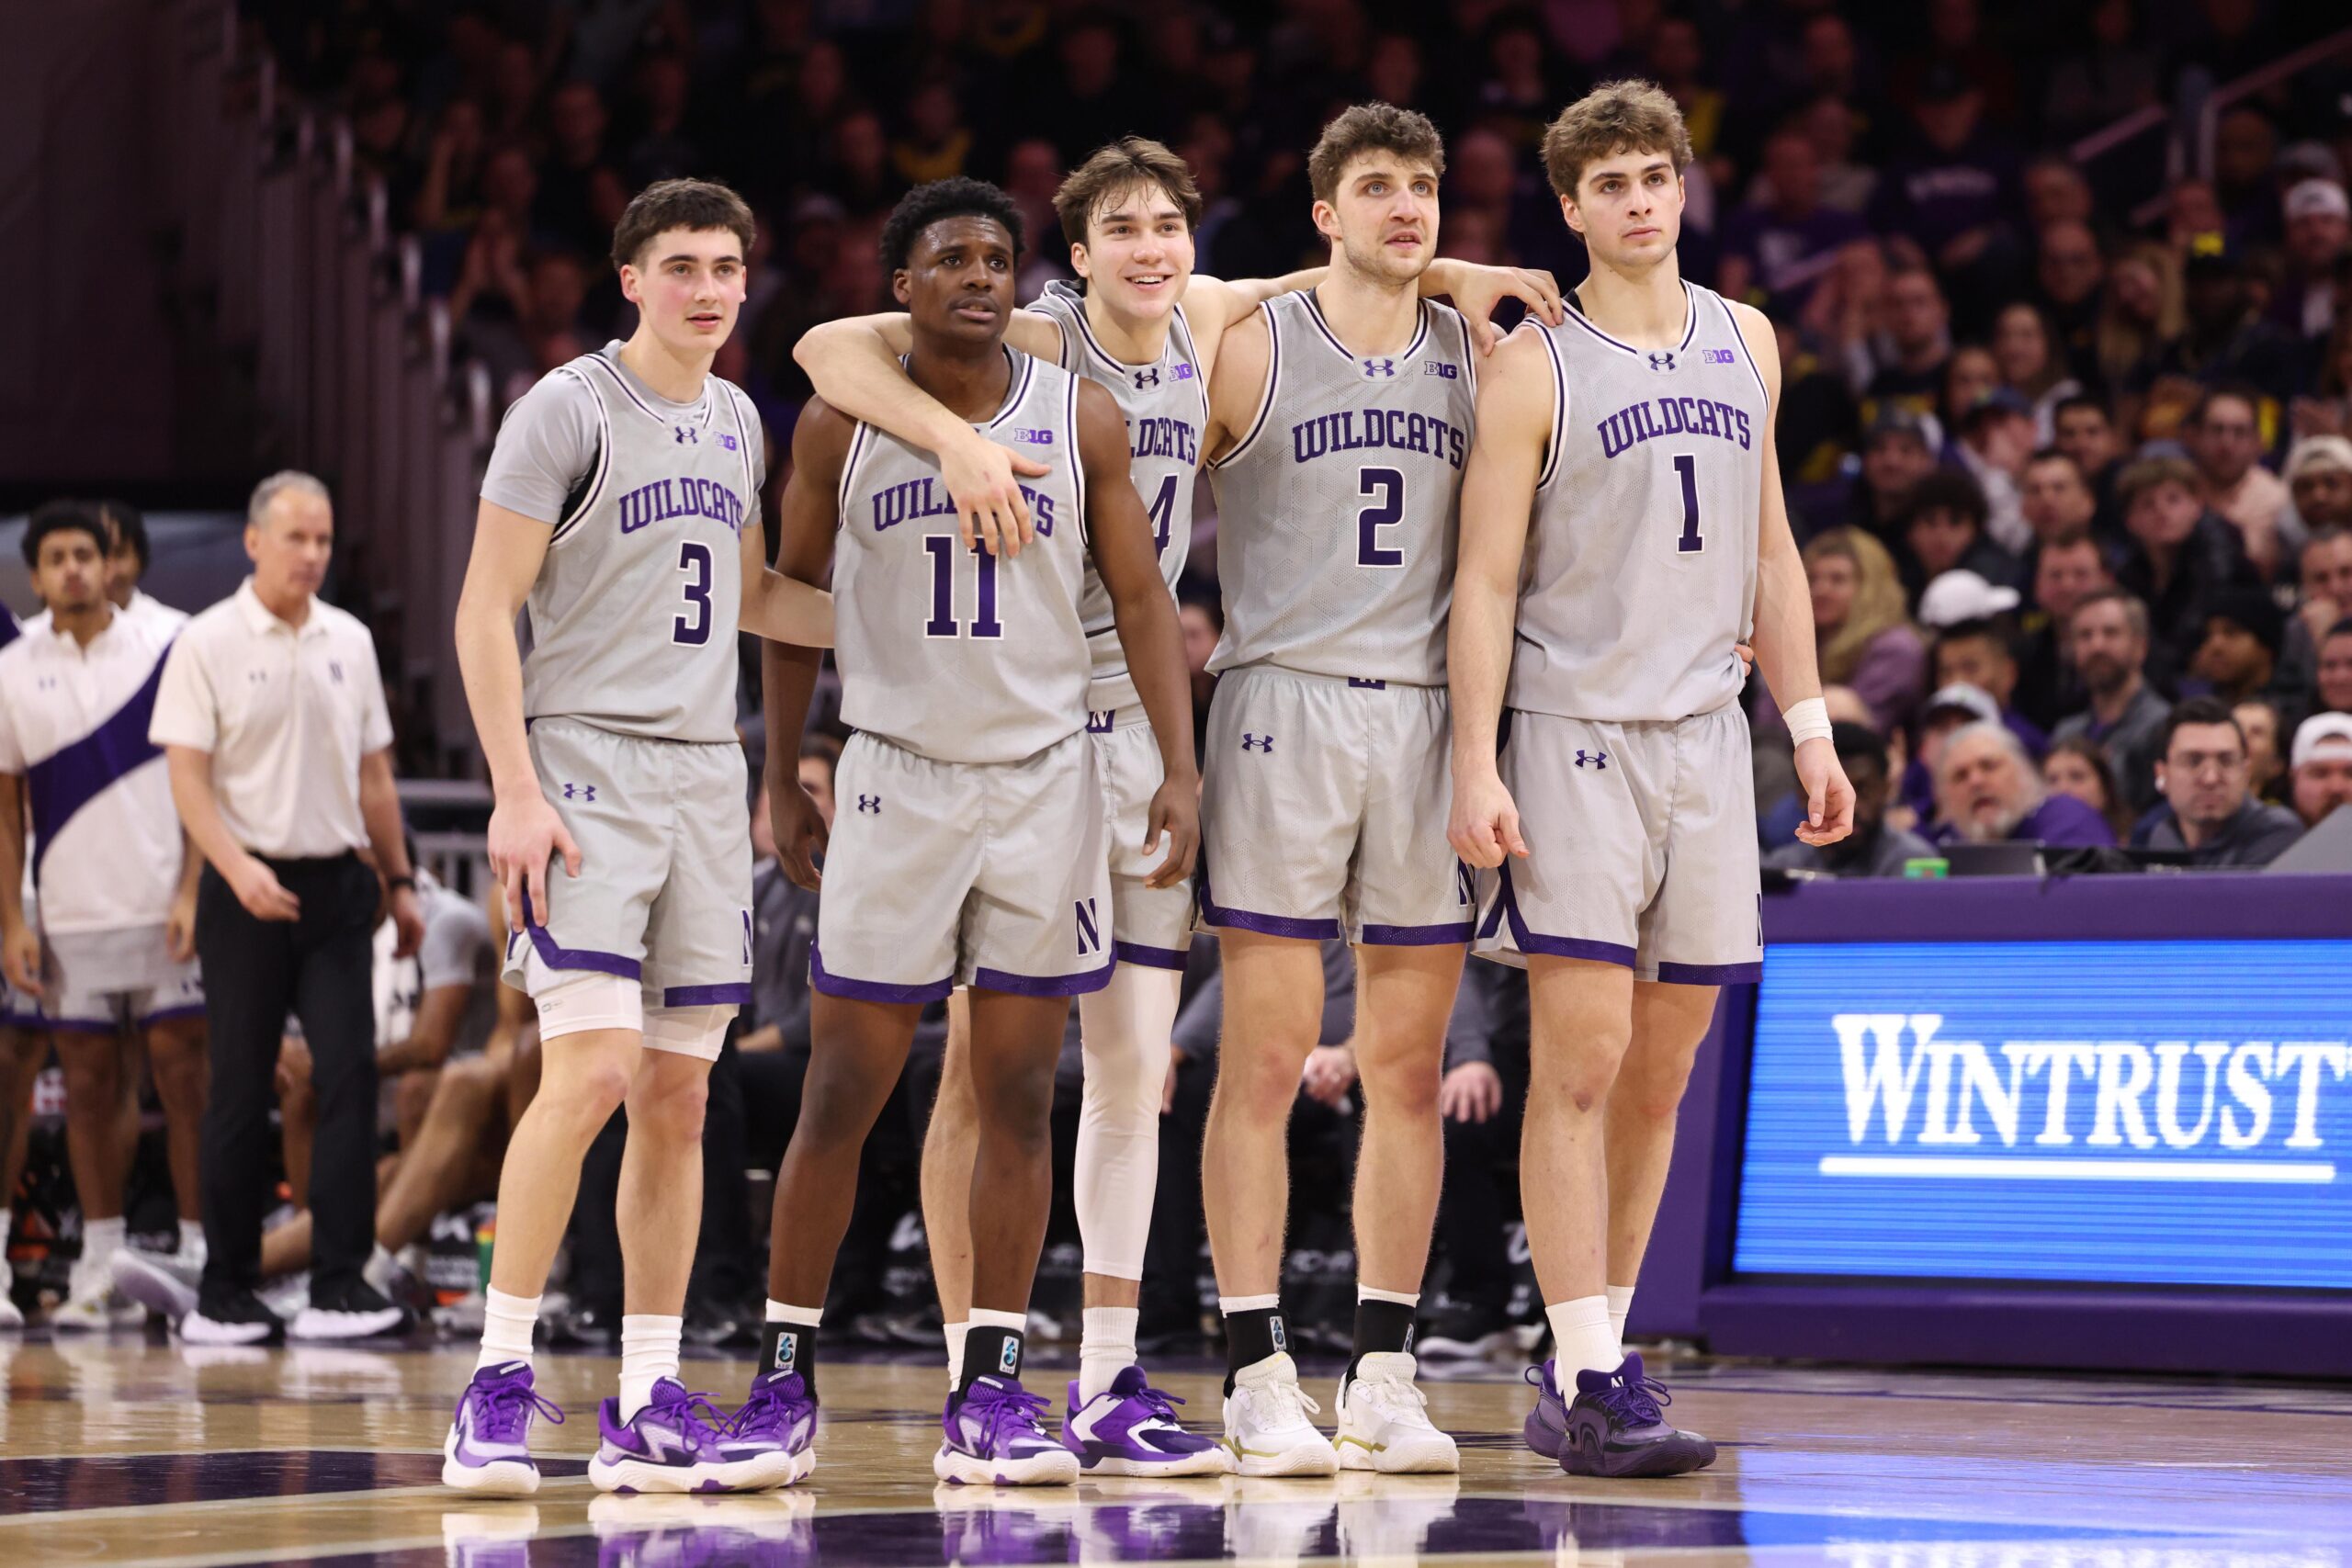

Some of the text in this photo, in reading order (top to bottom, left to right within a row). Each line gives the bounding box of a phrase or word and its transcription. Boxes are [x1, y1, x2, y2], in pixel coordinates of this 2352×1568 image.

[1292, 409, 1464, 470] WILDCATS
[1597, 397, 1751, 458] WILDCATS
[618, 477, 743, 544] WILDCATS
[1355, 466, 1406, 568] 2
[1671, 453, 1704, 555] 1
[671, 539, 714, 648] 3
[922, 534, 1004, 640] 11
[1073, 897, 1102, 956] N
[1831, 1013, 2348, 1149] WINTRUST
